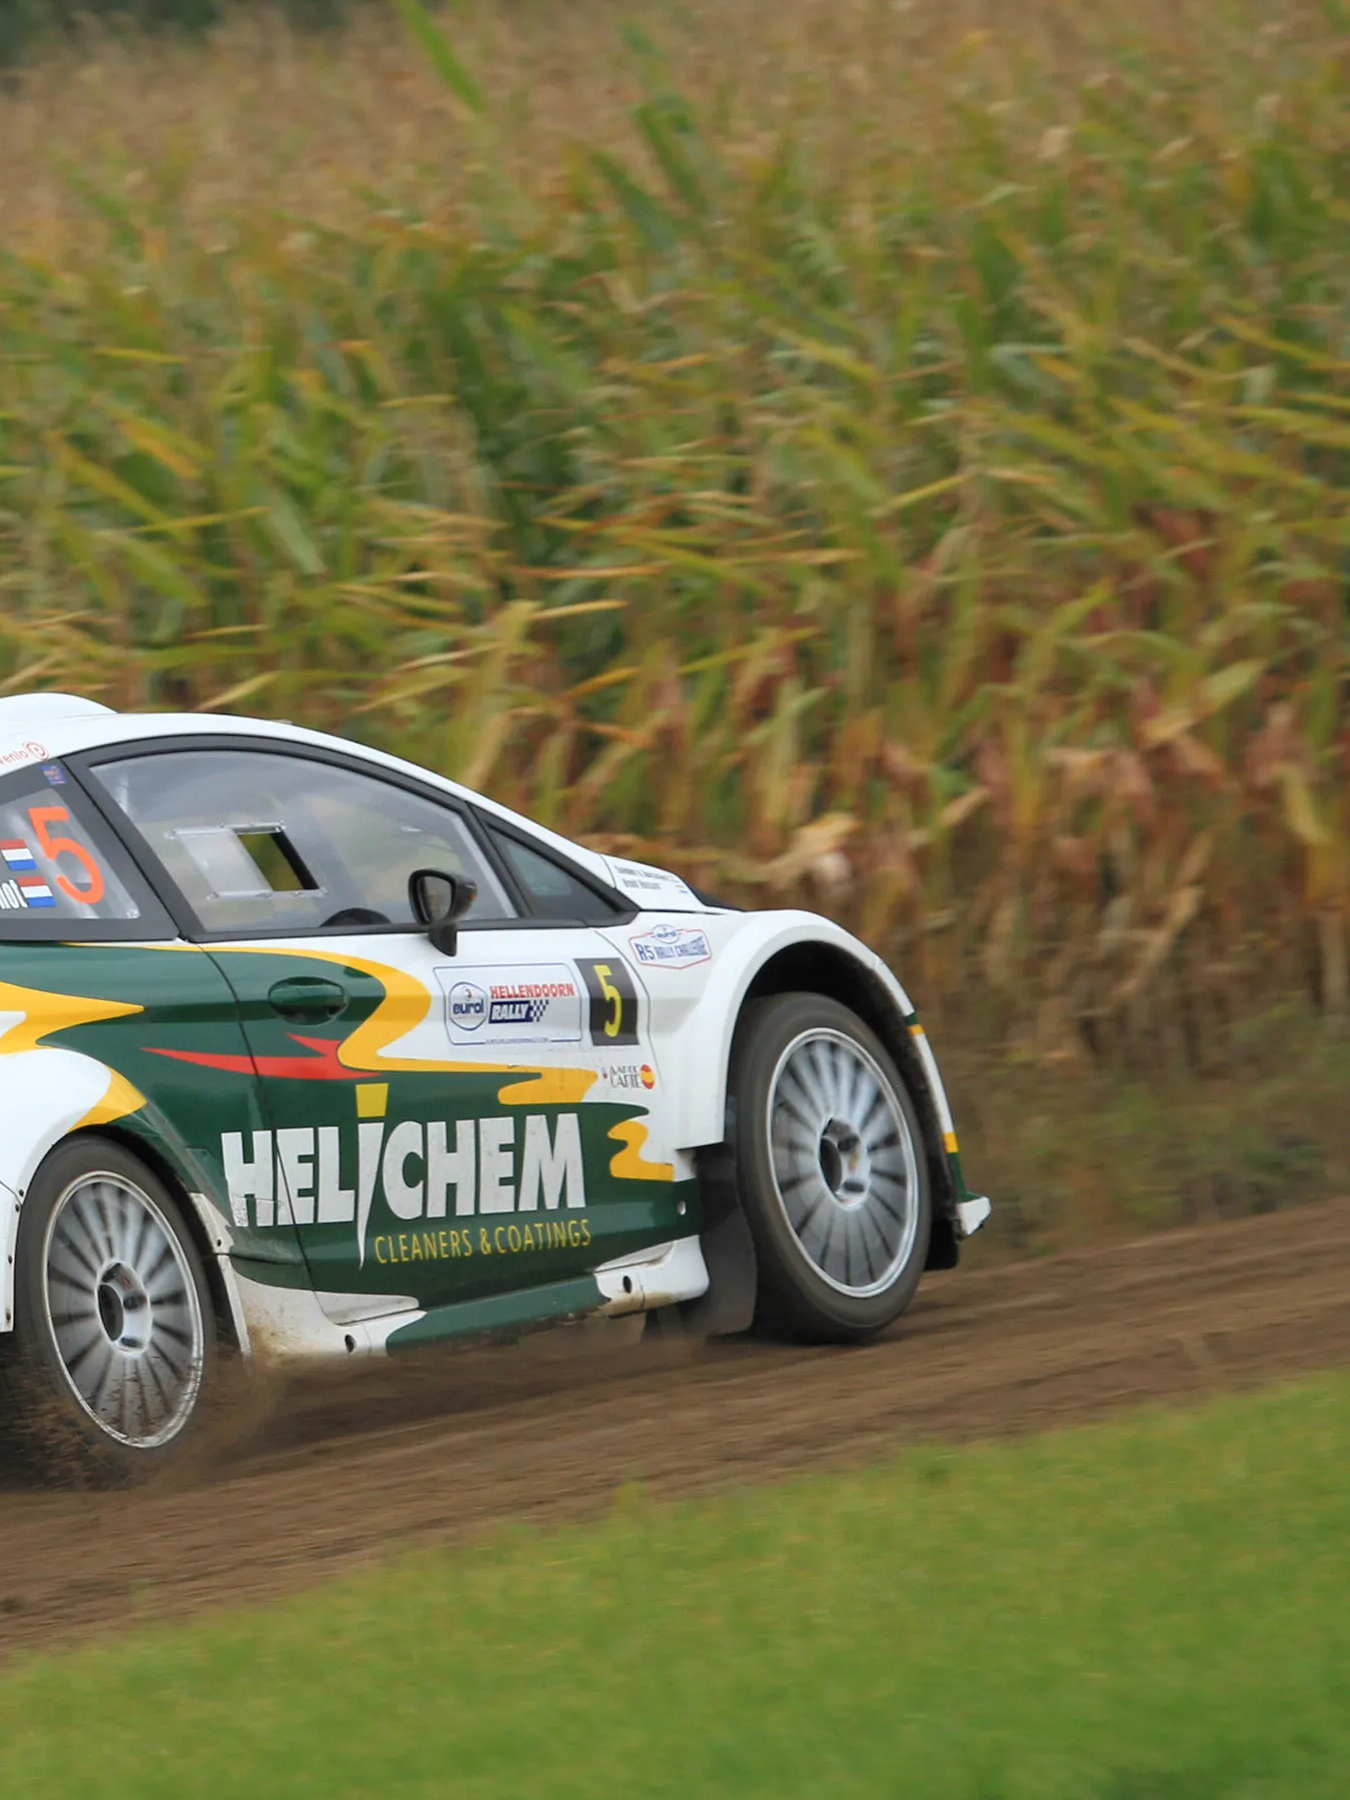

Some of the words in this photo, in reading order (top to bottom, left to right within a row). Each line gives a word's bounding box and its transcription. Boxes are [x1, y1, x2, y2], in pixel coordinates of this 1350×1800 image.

[28, 806, 105, 904] 5
[489, 983, 575, 999] HELLENDOORN
[491, 1003, 529, 1020] RALLY
[593, 965, 622, 1037] 5
[374, 1225, 474, 1265] CLEANERS
[494, 1218, 592, 1255] COATINGS
